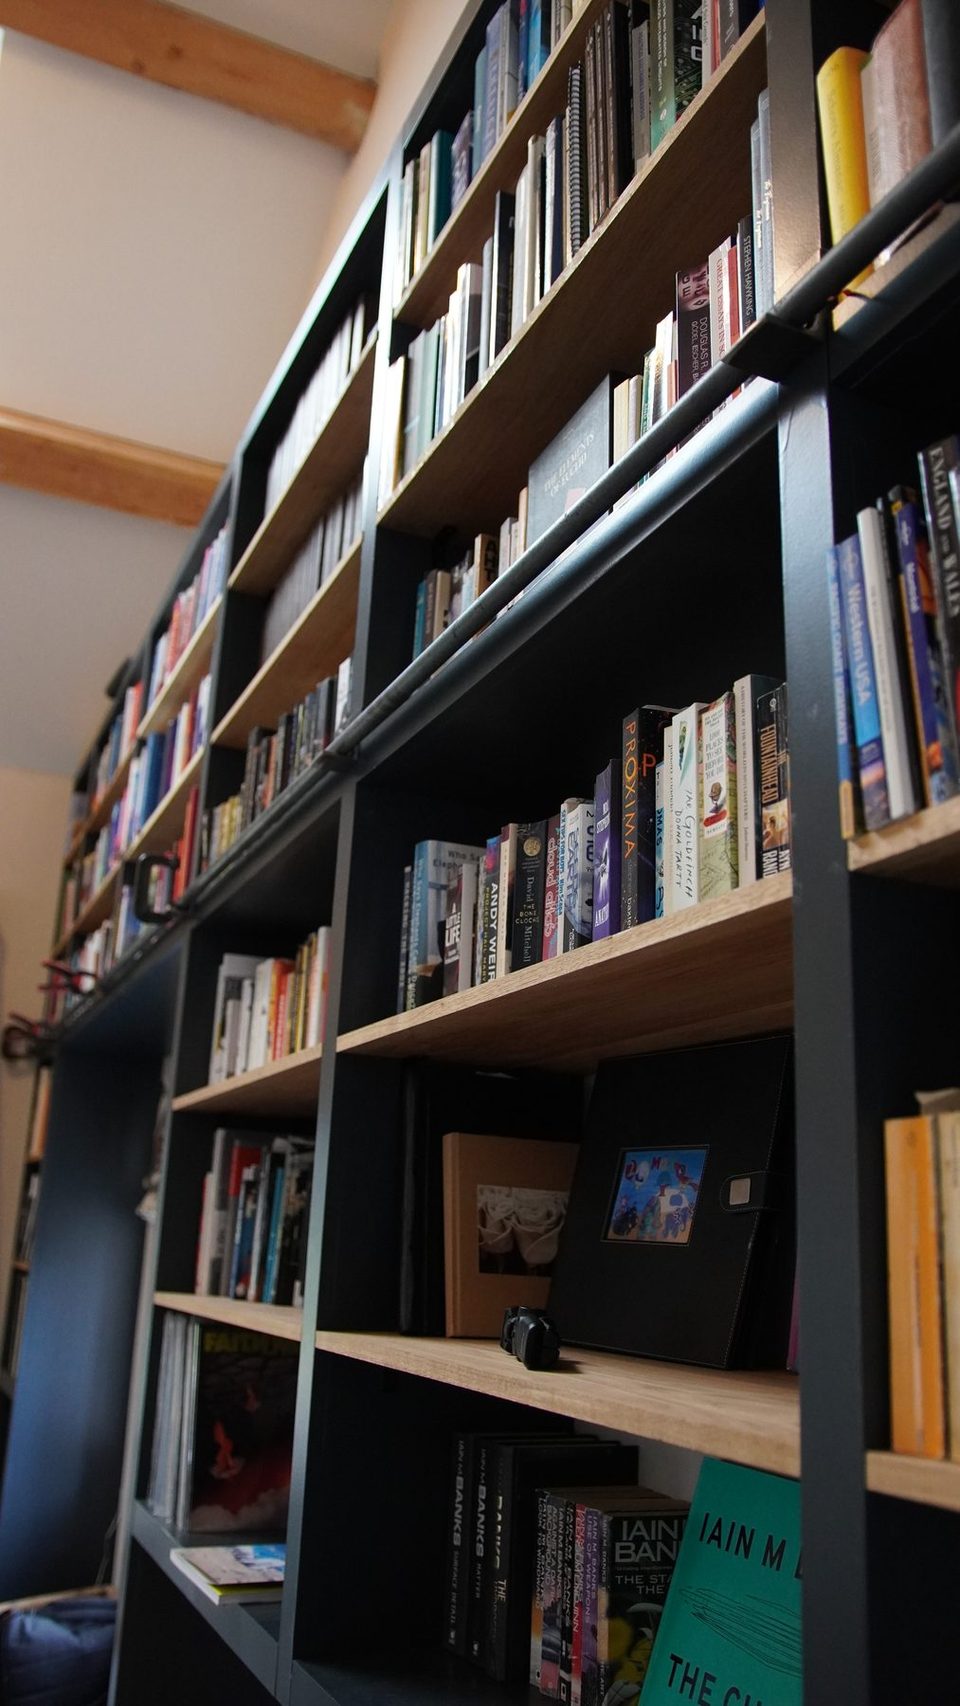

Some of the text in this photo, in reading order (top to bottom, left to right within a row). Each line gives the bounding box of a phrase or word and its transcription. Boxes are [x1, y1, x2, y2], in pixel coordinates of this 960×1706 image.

[743, 235, 751, 272] STEPHEN
[716, 258, 724, 292] GREAT
[745, 272, 754, 316] HAWKING
[699, 317, 708, 360] DOUGLAS
[928, 446, 951, 530] ENGLAND
[846, 584, 873, 705] Western USA
[760, 723, 779, 805] FOUNTAINHEAD
[623, 720, 638, 859] PROXIMA
[674, 809, 683, 888] DONNA TARTT
[683, 814, 696, 898] GOLDFINCH
[762, 850, 779, 877] RAND
[778, 848, 790, 870] AYN
[489, 882, 499, 929] ANDY
[526, 875, 536, 902] David
[543, 837, 558, 938] cloud atlas
[444, 924, 461, 947] LIFE
[522, 925, 535, 963] Mitchell
[457, 1440, 465, 1465] IAIN
[452, 1476, 465, 1547] BANKS
[475, 1484, 487, 1558] BANKS
[622, 1519, 678, 1541] IAIN
[537, 1532, 543, 1546] TO
[586, 1542, 592, 1559] OF
[615, 1541, 677, 1563] BAN
[699, 1512, 756, 1560] IAIN
[762, 1534, 787, 1571] M
[498, 1579, 507, 1602] THE
[615, 1575, 644, 1585] THE
[636, 1585, 665, 1595] THE
[668, 1653, 718, 1706] THE
